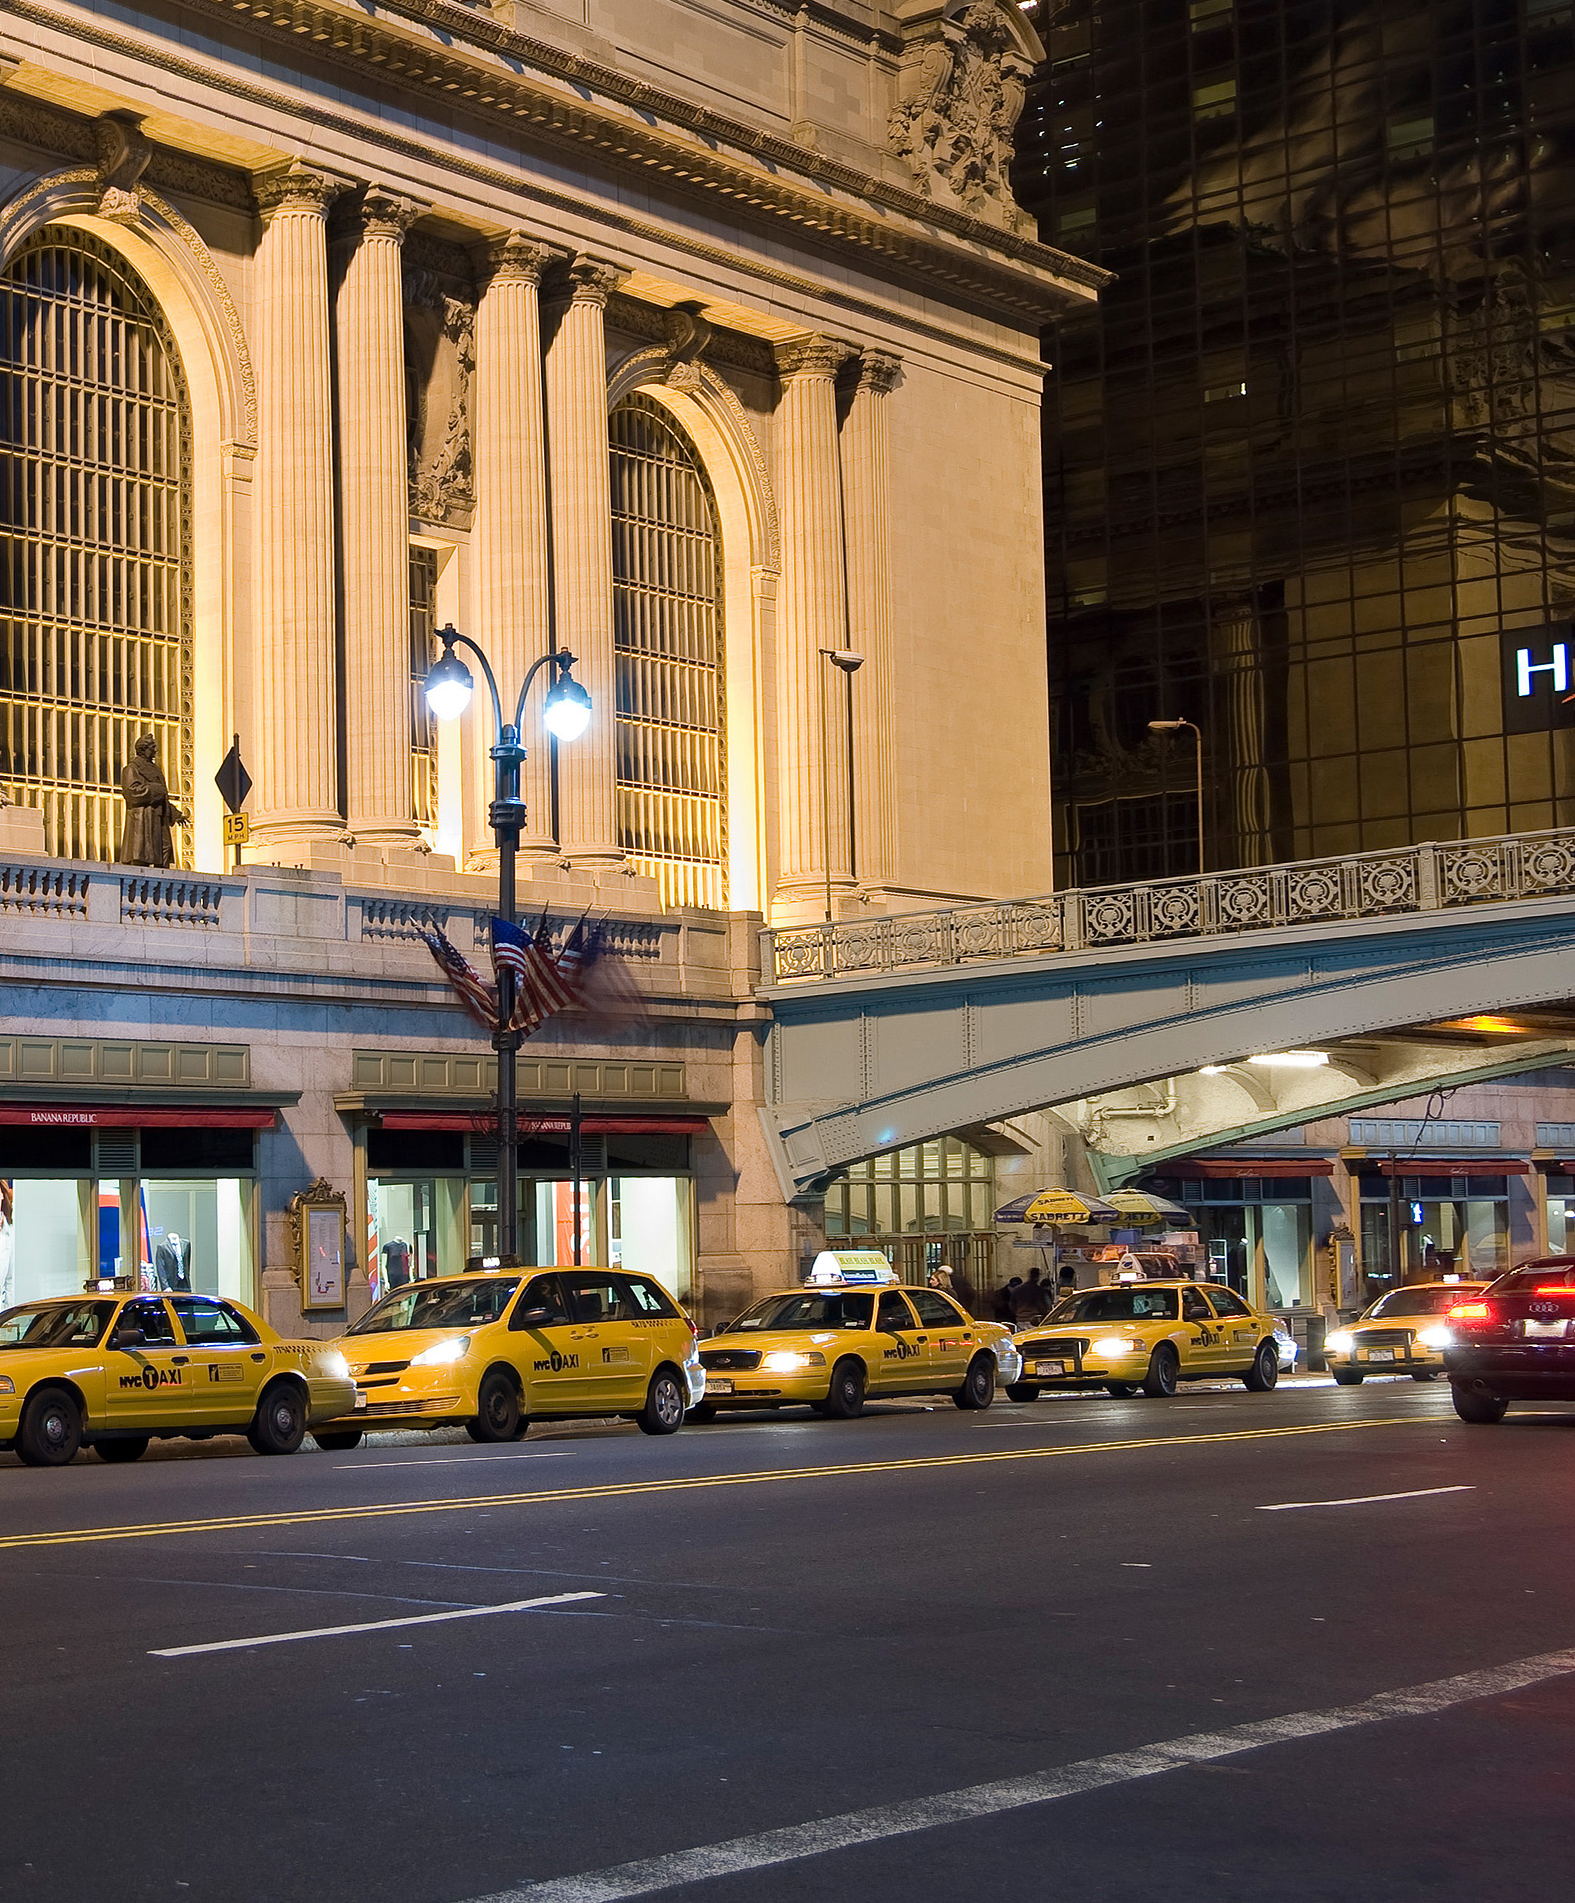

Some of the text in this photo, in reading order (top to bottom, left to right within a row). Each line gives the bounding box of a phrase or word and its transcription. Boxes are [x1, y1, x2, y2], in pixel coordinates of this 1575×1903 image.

[31, 1113, 98, 1123] BANANA REPUBLIC
[1031, 1212, 1087, 1221] SABRETT
[883, 1348, 897, 1359] NYC
[534, 1353, 579, 1371] NYC TAXI
[119, 1368, 182, 1388] NYC TAXI
